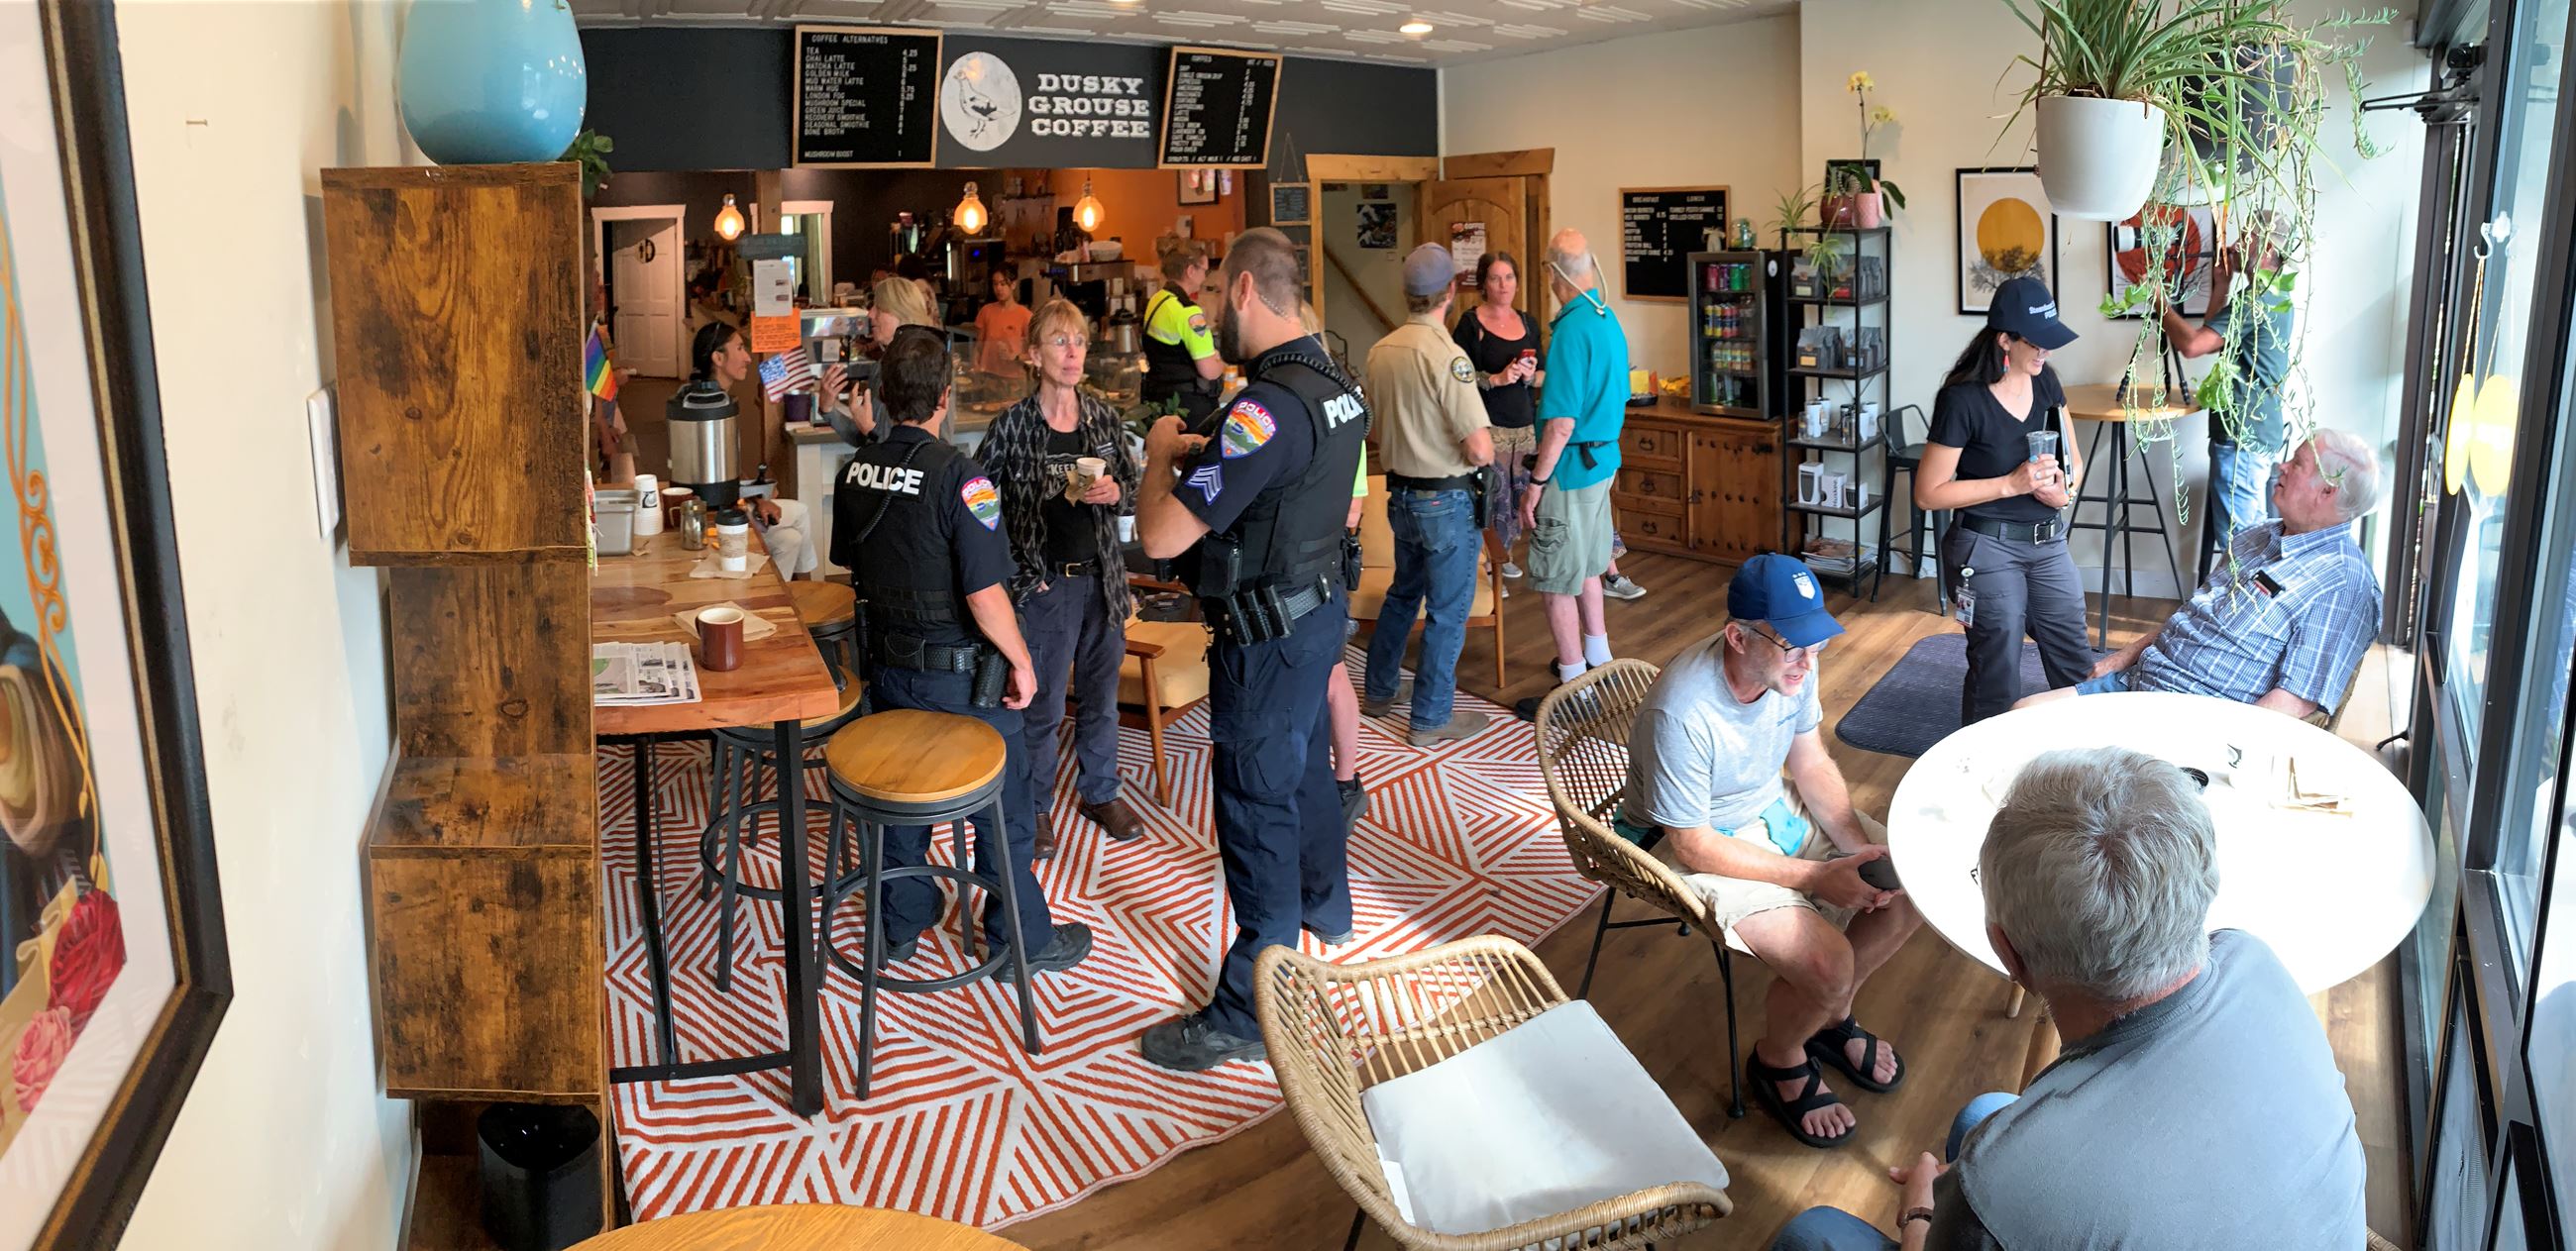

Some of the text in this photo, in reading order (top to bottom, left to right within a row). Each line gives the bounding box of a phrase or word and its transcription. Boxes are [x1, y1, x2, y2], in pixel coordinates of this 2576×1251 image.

[1037, 73, 1143, 95] DUSKY
[1028, 96, 1150, 117] GROUSE
[1031, 118, 1150, 138] COFFEE
[845, 462, 924, 495] POLICE
